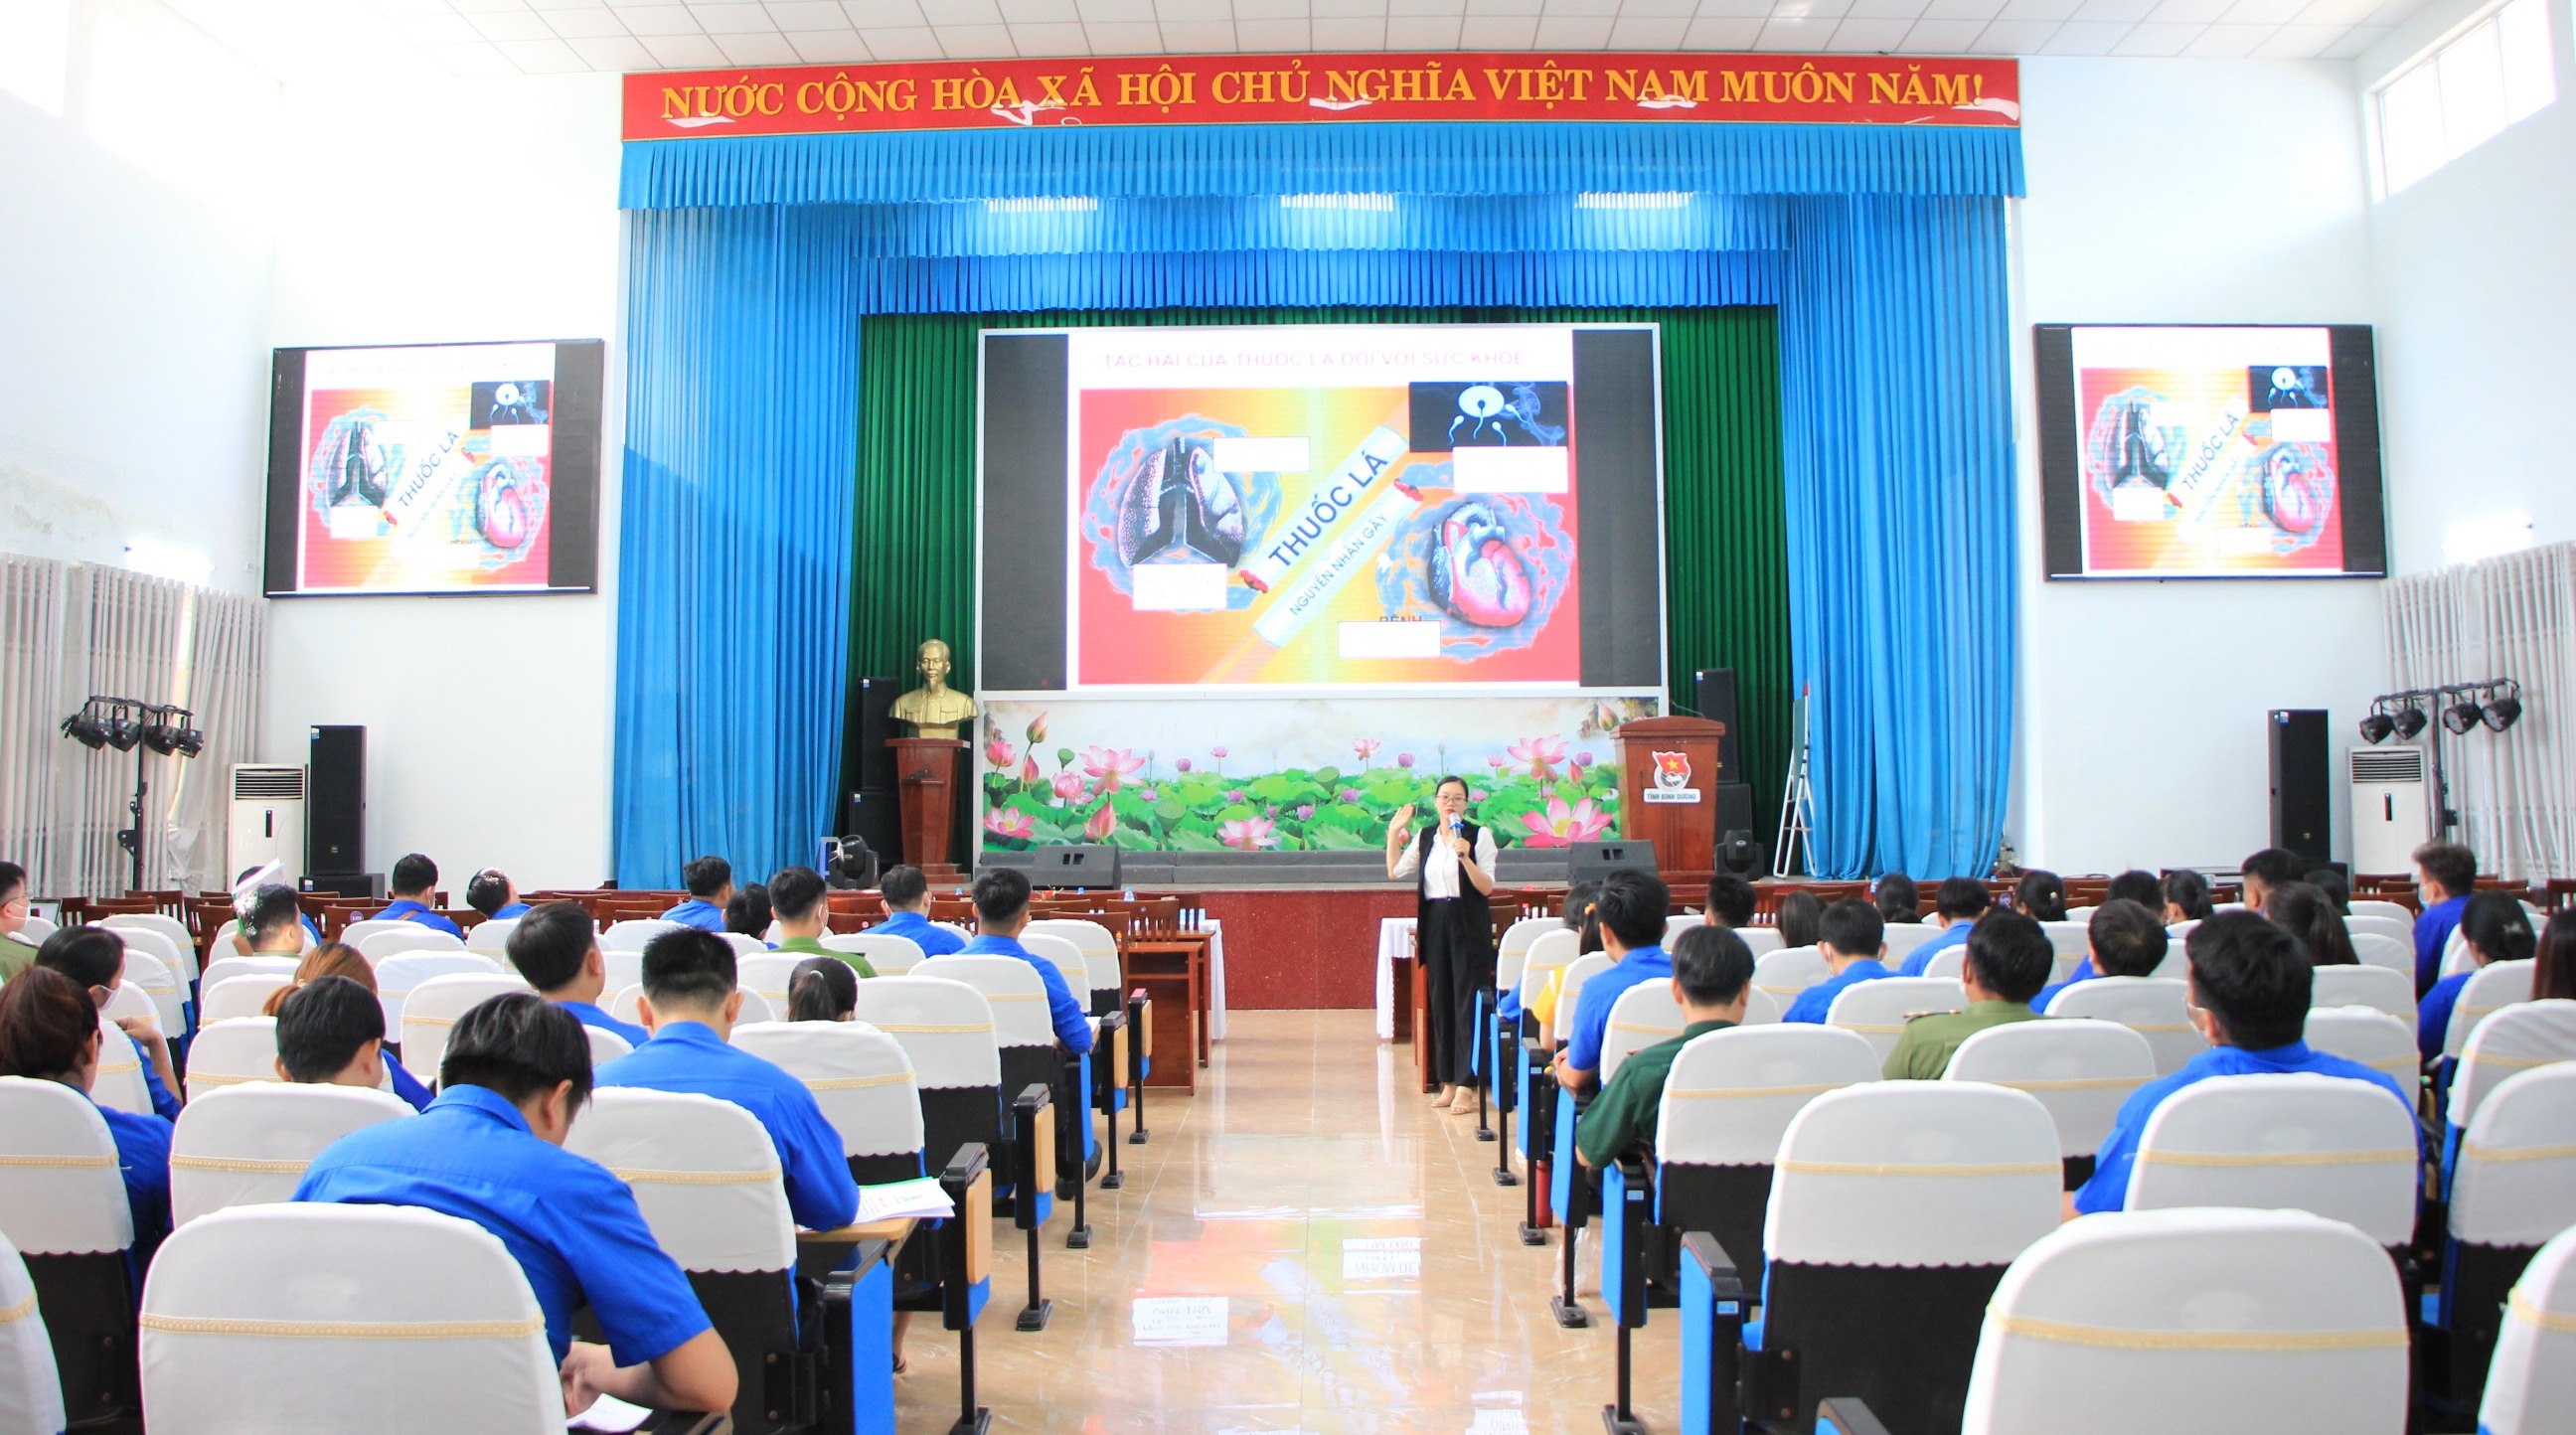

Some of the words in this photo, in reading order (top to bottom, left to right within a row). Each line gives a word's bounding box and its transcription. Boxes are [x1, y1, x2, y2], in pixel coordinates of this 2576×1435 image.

[661, 75, 784, 118] NƯỚC
[796, 72, 918, 121] CỘNG
[931, 68, 1025, 110] HÒA
[1037, 66, 1103, 107] XÃ
[1117, 64, 1197, 113] HỘI
[1211, 59, 1311, 104] CHỦ
[1325, 61, 1477, 102] NGHĨA
[1484, 59, 1593, 110] VIỆT
[1604, 69, 1709, 102] NAM
[1720, 62, 1855, 103] MUÔN
[1867, 64, 1984, 106] NĂM!
[1268, 486, 1353, 566] THUỐC
[1348, 449, 1389, 488] LÁ
[1289, 569, 1335, 616] NGUYÊN
